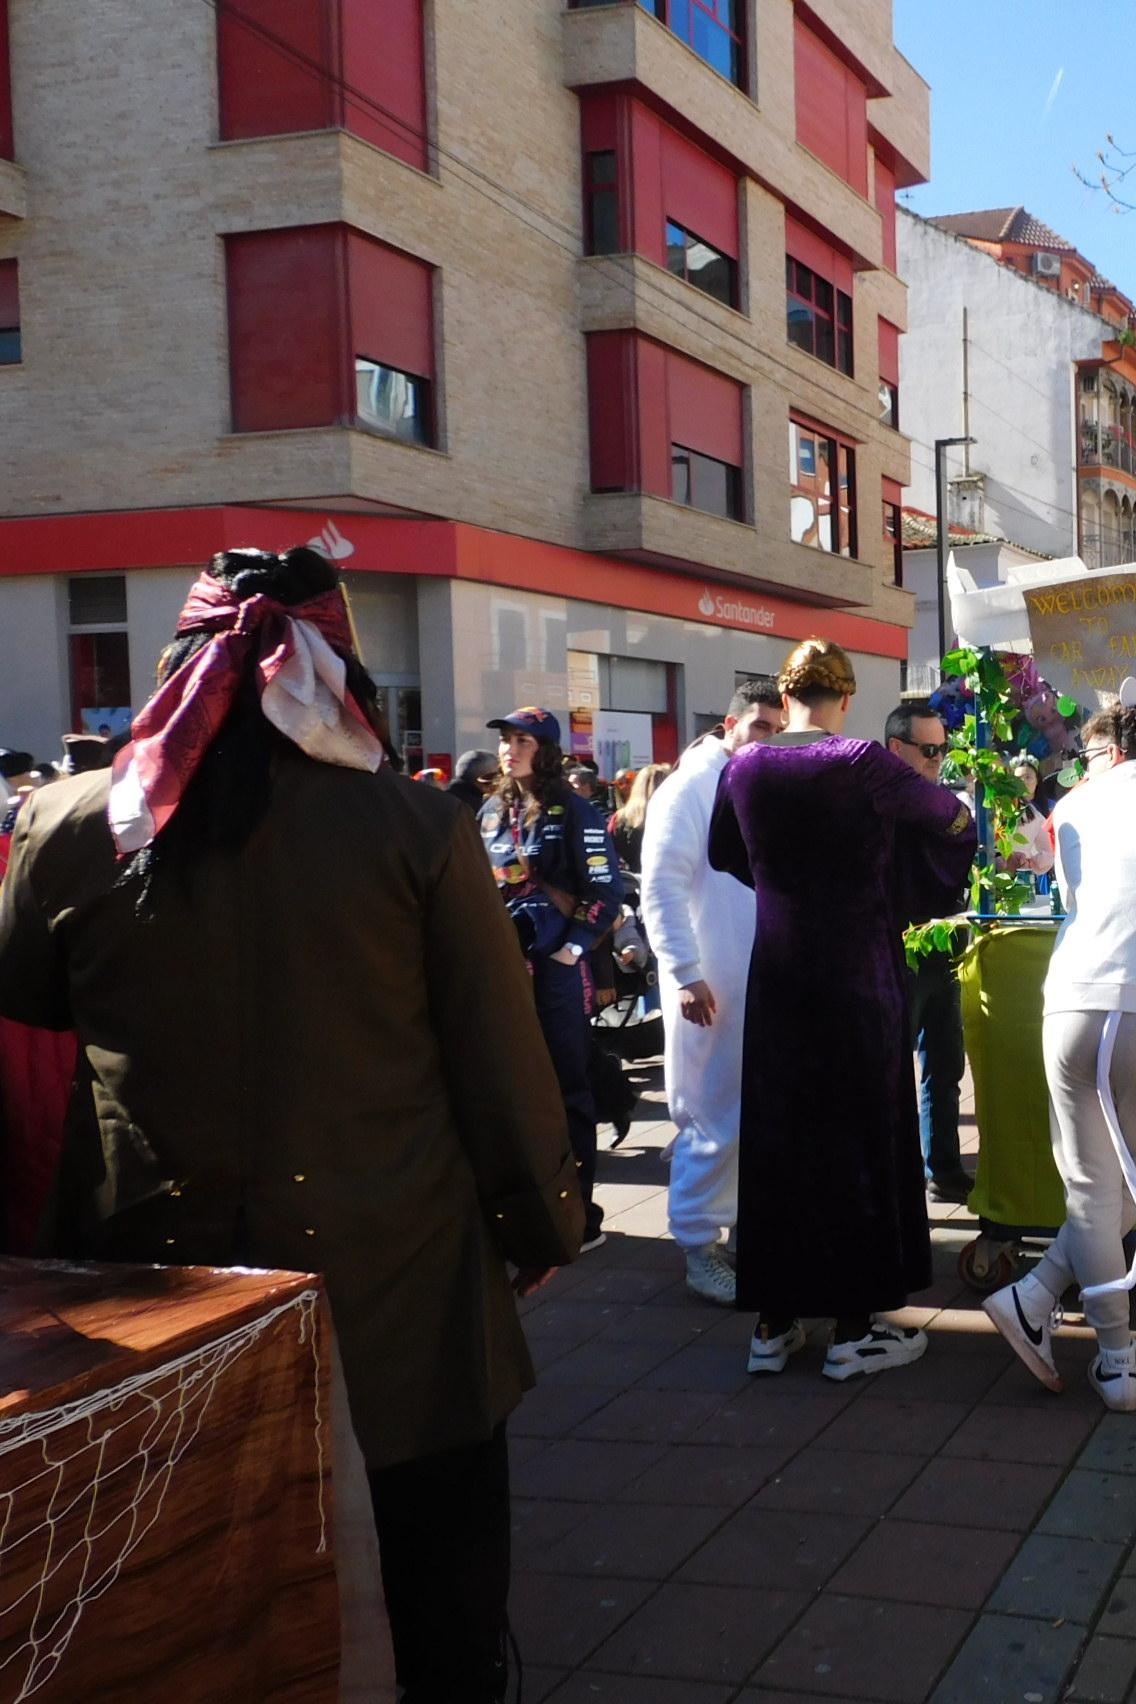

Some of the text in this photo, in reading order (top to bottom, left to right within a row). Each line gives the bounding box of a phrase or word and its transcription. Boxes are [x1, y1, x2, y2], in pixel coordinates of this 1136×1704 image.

[715, 596, 775, 628] Santander
[1080, 615, 1109, 636] TO
[490, 843, 541, 856] ORLE
